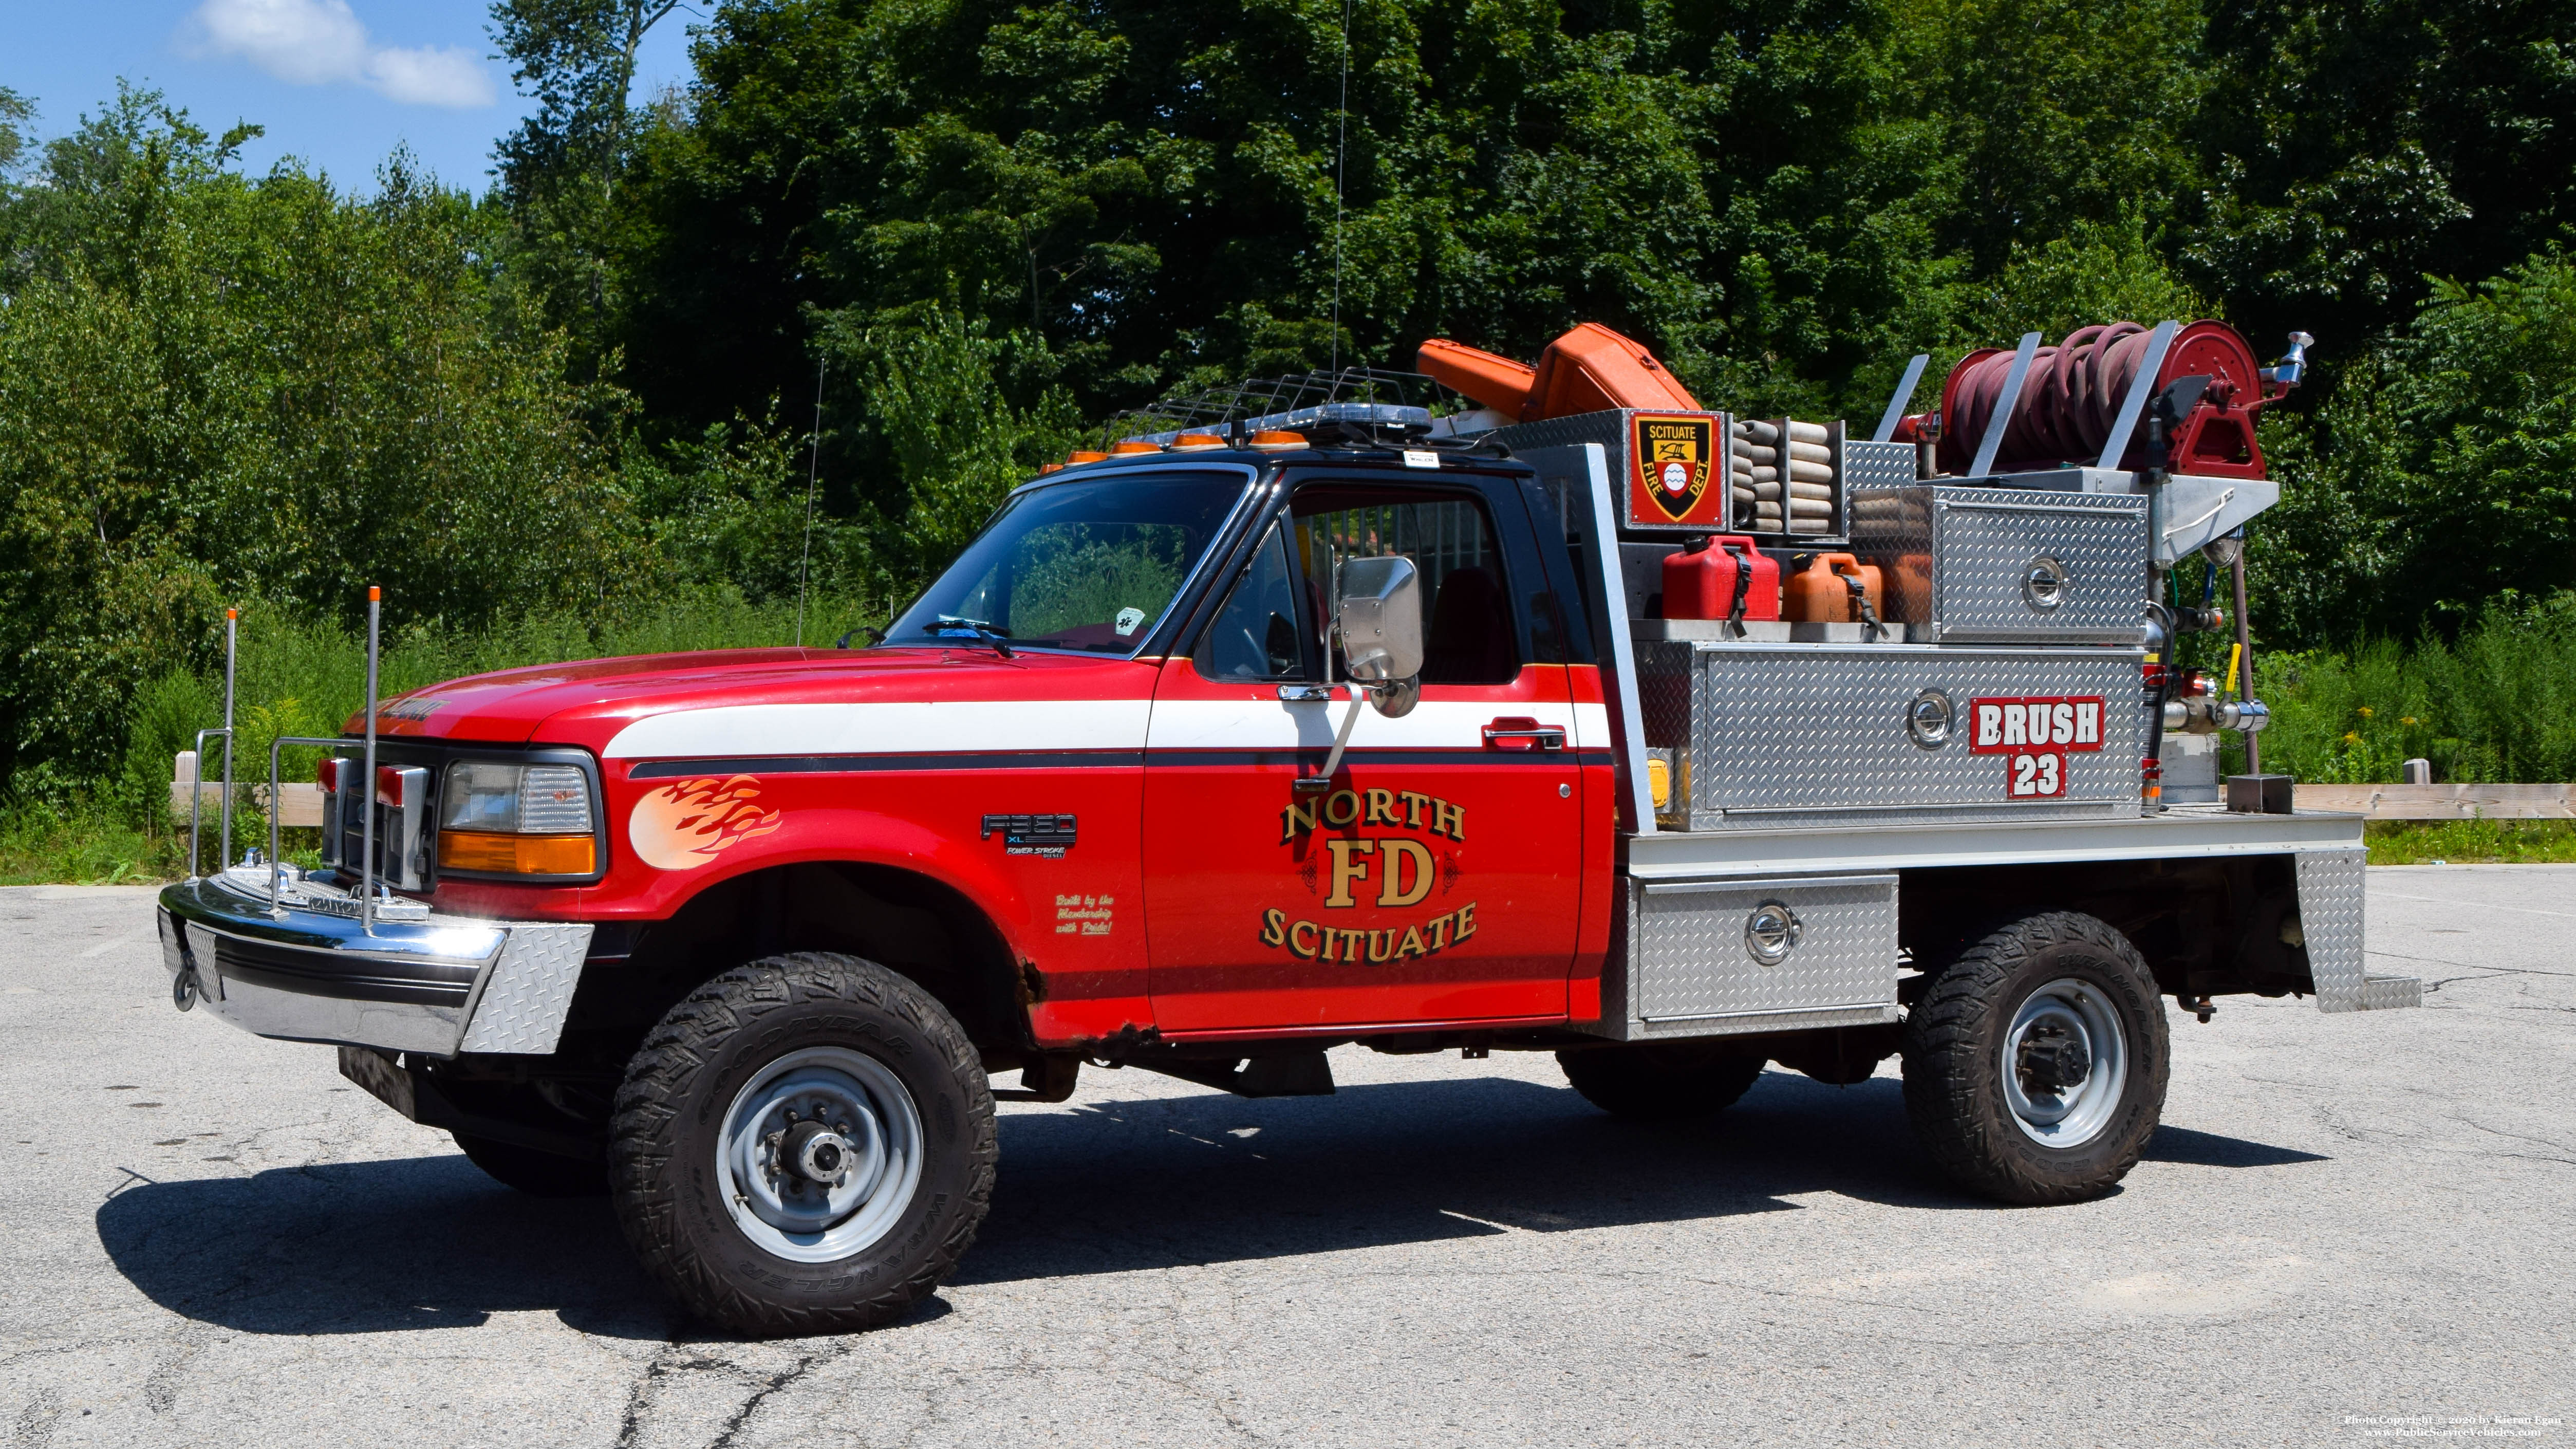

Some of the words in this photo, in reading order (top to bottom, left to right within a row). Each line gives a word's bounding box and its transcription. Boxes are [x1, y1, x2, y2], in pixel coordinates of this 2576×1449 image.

[1649, 425, 1696, 439] SCITUATE
[1644, 462, 1664, 496] FIRE
[1689, 459, 1708, 496] DEPT.
[1977, 702, 2100, 746] BRUSH
[2014, 753, 2059, 796] 23
[1280, 788, 1466, 845] NORTH
[1324, 838, 1436, 908] FD
[1056, 895, 1081, 906] Built
[1085, 895, 1095, 908] by
[1099, 895, 1114, 905] the
[1057, 907, 1112, 920] Membership
[1056, 922, 1077, 933] with
[1081, 921, 1113, 934] Pride!
[1262, 901, 1478, 964] SCITUATE
[2057, 953, 2152, 1076] WRANGLER
[698, 1014, 913, 1125] GOODYEAR
[738, 1193, 948, 1292] WRANGLER
